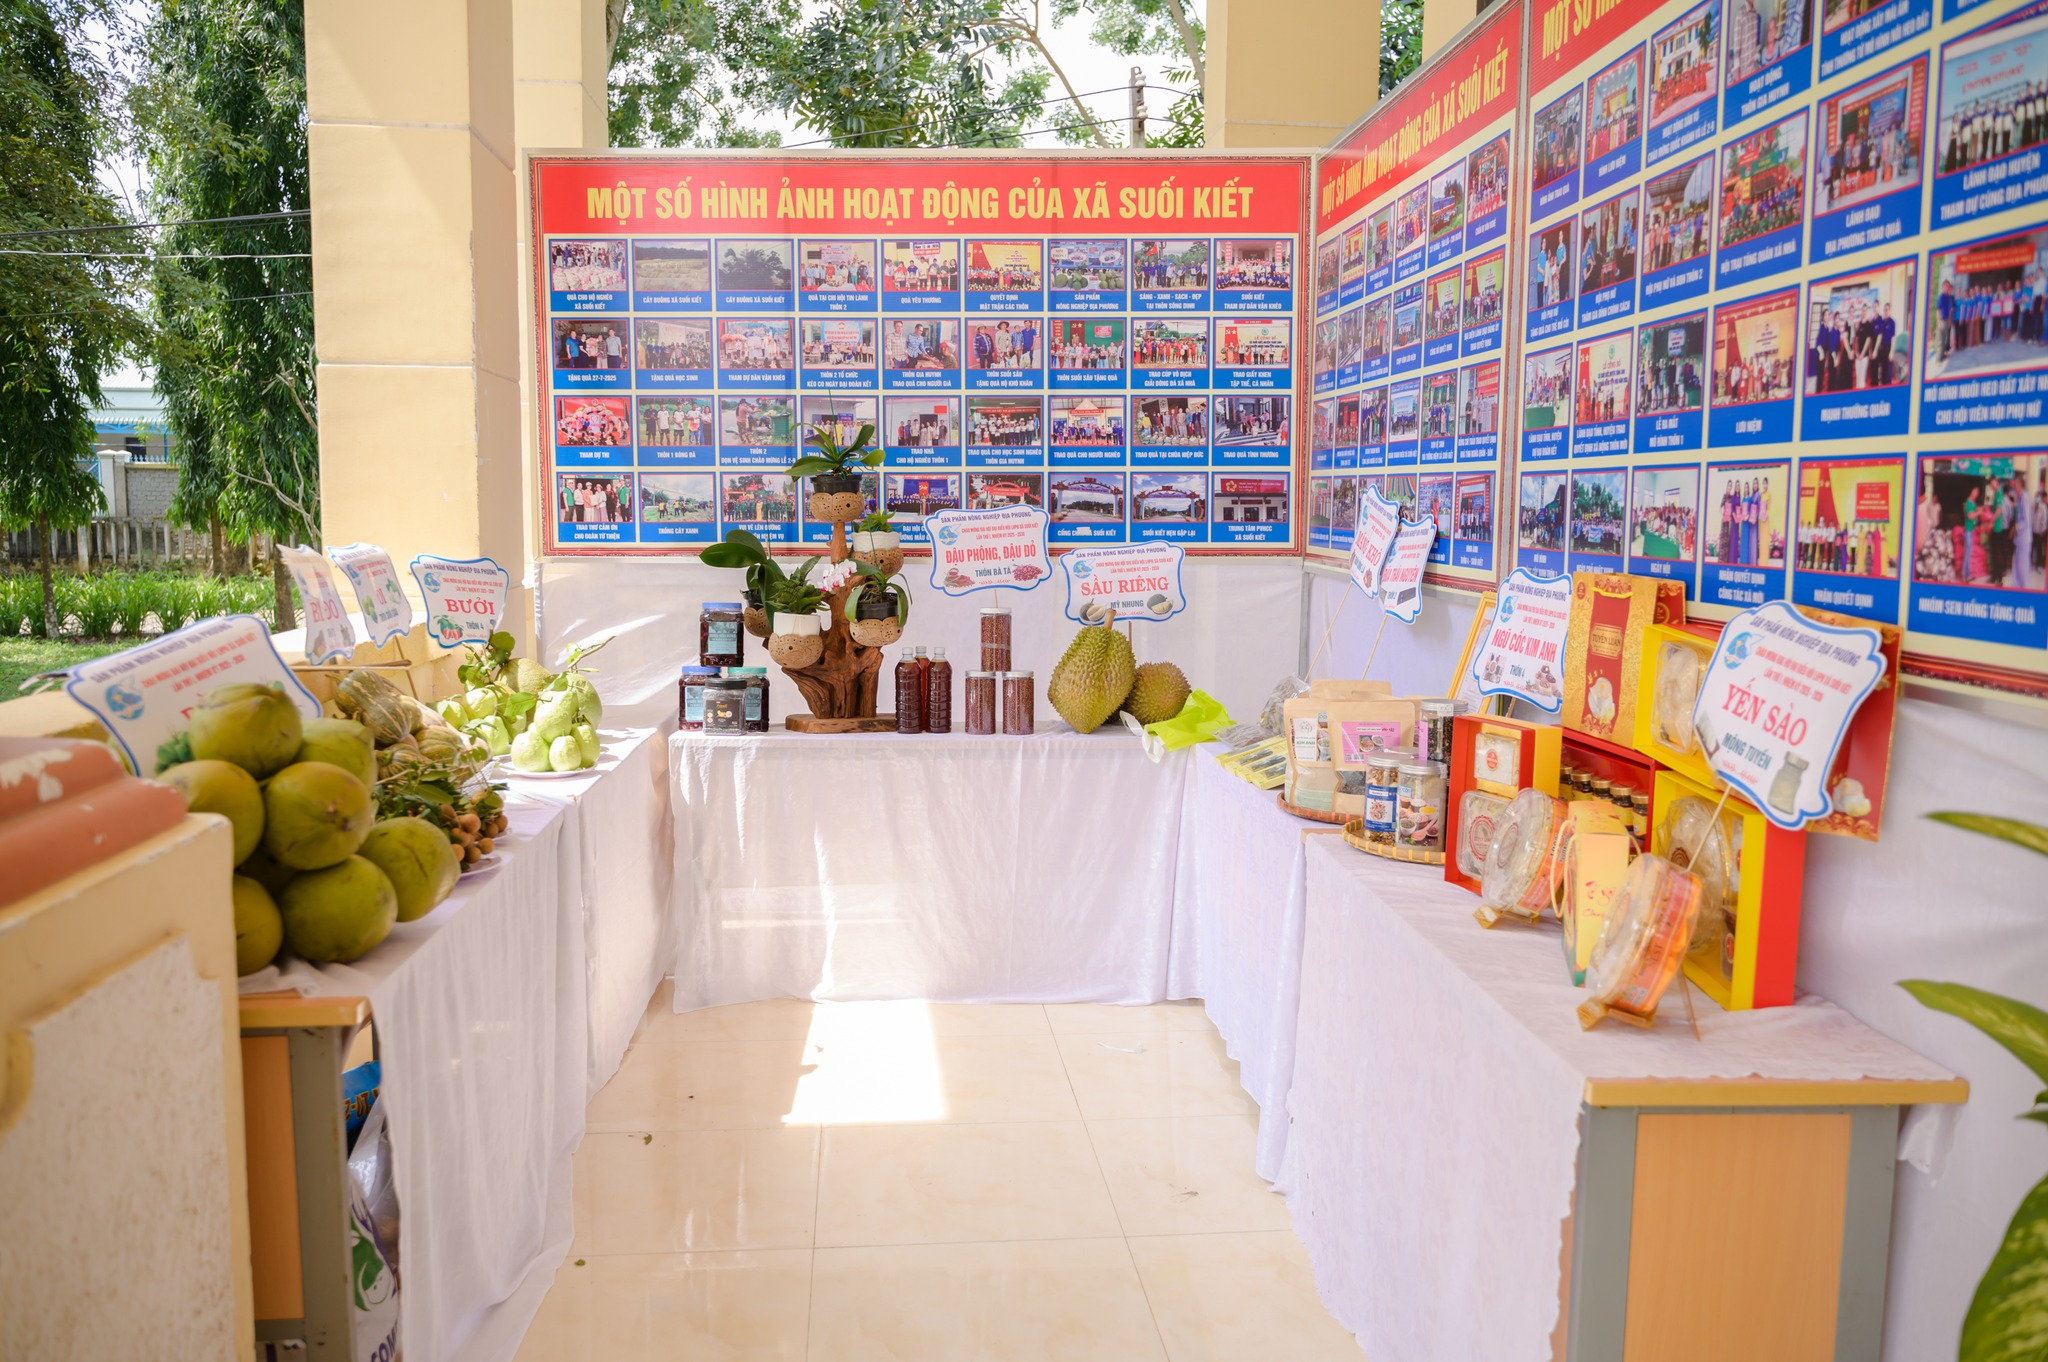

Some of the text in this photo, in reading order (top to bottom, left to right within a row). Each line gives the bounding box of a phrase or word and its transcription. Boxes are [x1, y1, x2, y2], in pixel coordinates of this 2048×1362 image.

[1322, 37, 1509, 219] MỘT SỐ HÌNH ẢNH HOẠT ĐỘNG CỦA XÃ SUỐI KIẾT
[587, 176, 1253, 225] MỘT SỐ HÌNH ẢNH HOẠT ĐỘNG CỦA XÃ SUỐI KIẾT
[946, 540, 1036, 566] ĐẬU PHỘNG, ĐẬU ĐỎ
[975, 566, 1010, 577] THÔN BÀ TÁ
[1081, 575, 1168, 596] SẦU RIÊNG
[445, 597, 495, 615] BƯỞI
[1110, 599, 1143, 610] MỸ NHUNG
[1492, 628, 1558, 662] NGŨ CỐC KIM ANH
[1722, 677, 1765, 725] YẾN
[1762, 702, 1808, 747] SÀO
